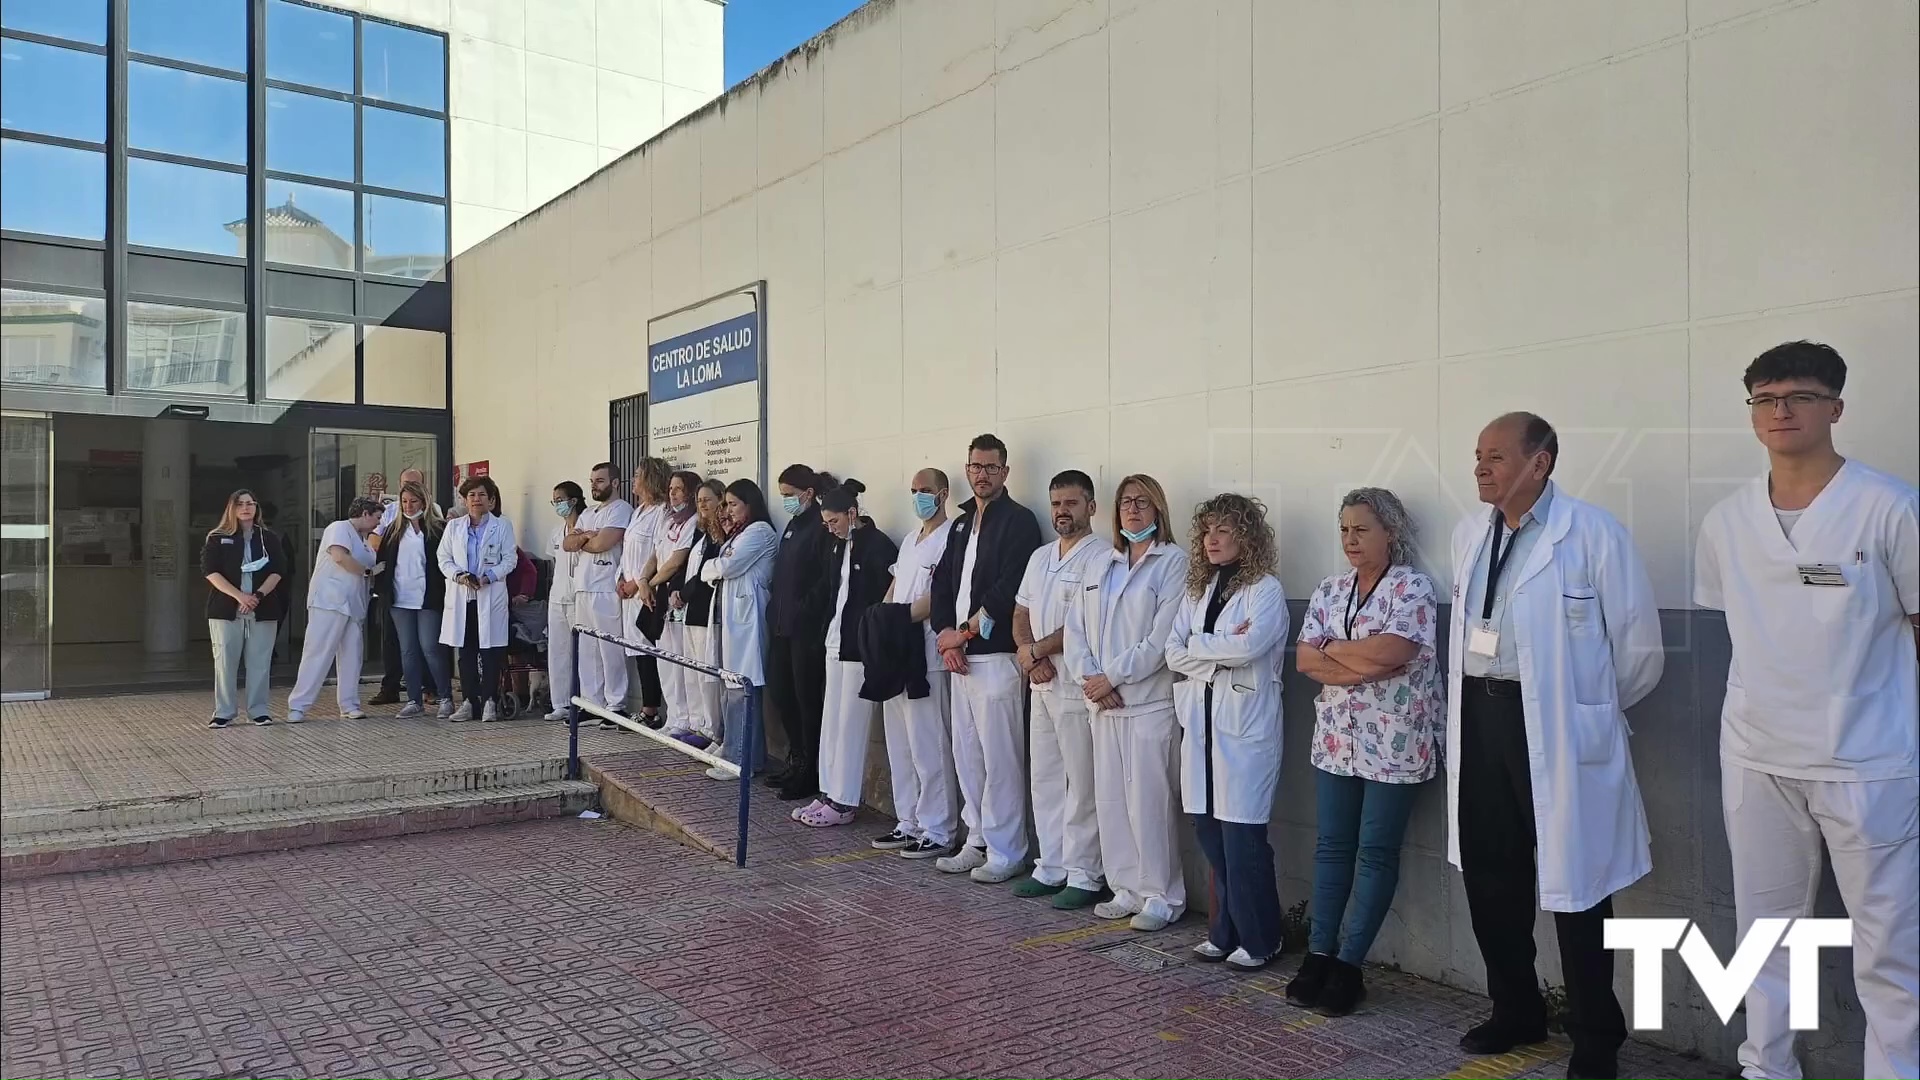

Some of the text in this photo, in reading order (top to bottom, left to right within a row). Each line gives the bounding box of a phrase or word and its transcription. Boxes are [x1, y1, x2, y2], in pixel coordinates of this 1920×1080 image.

[652, 328, 752, 373] CENTRO DE SALUD
[677, 360, 722, 389] LA LOMA
[652, 426, 671, 437] Cartera
[672, 424, 678, 432] de
[728, 435, 741, 443] Social
